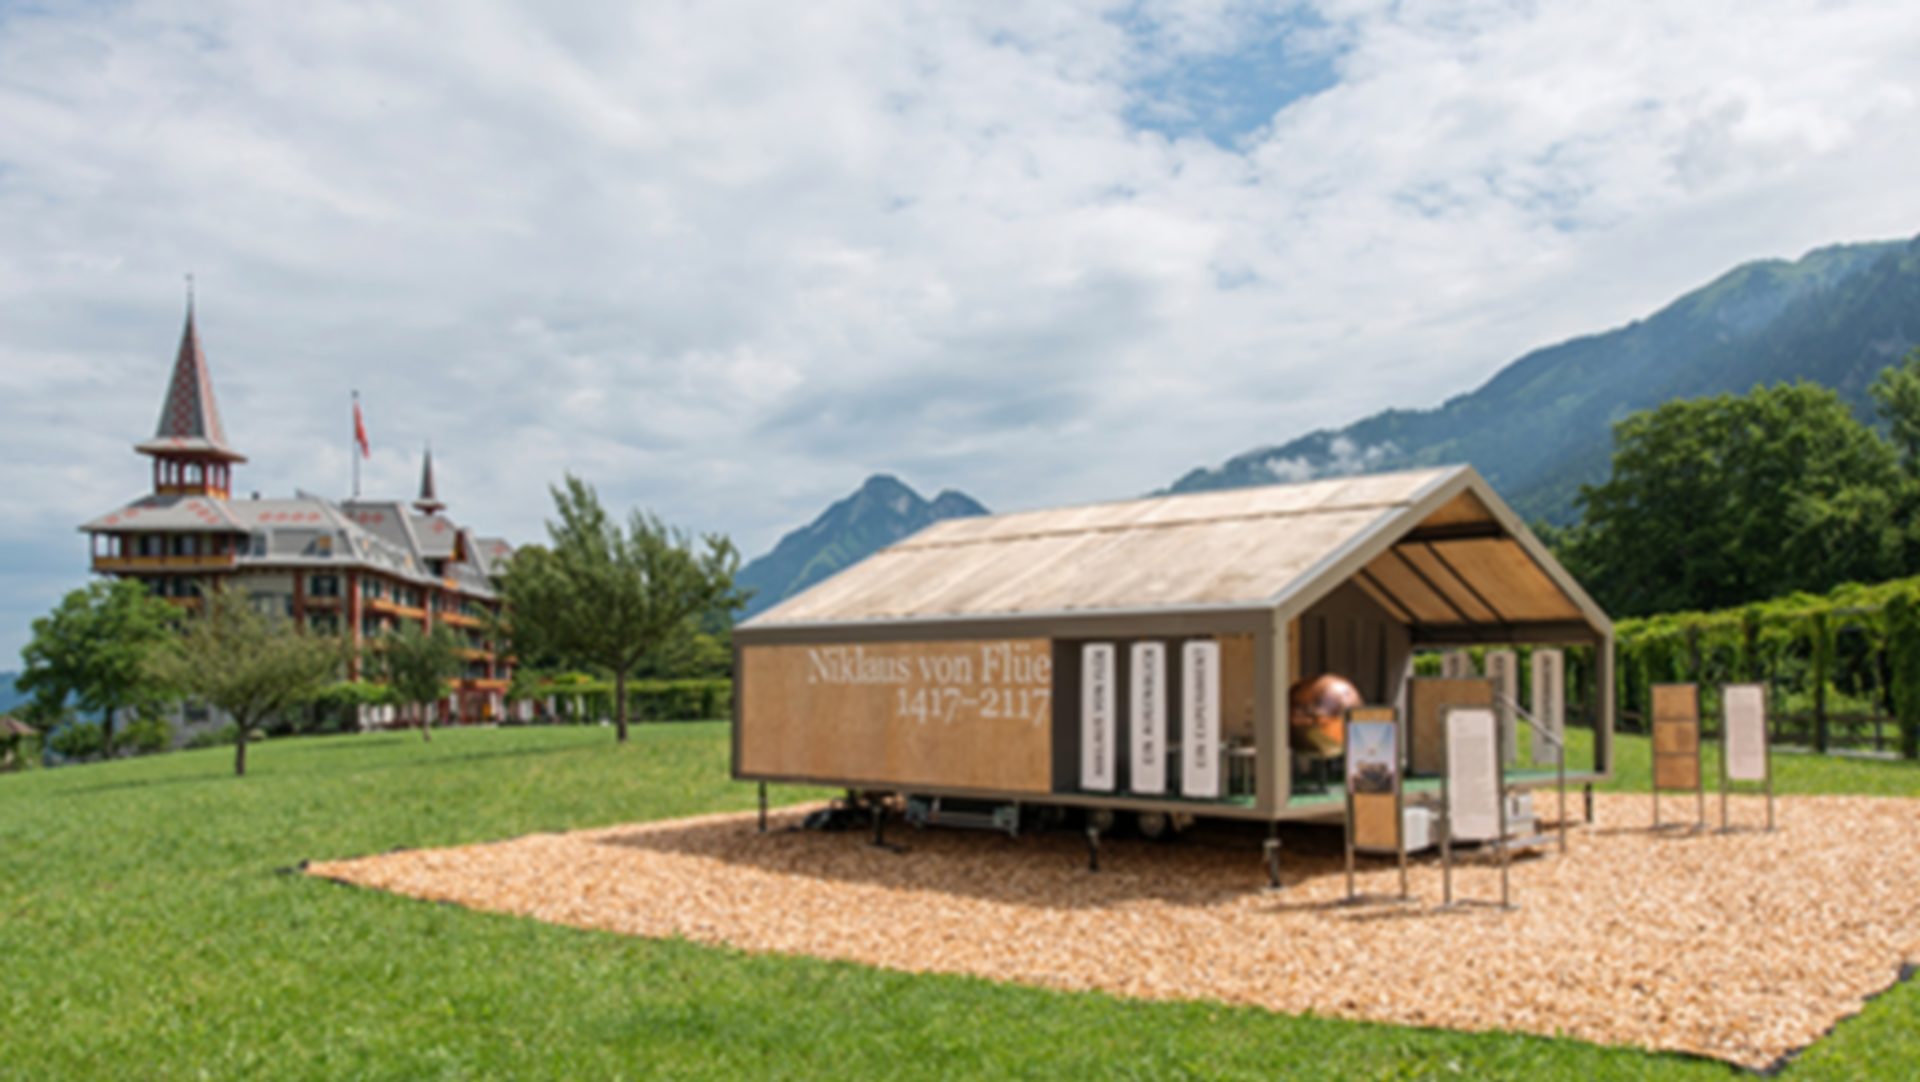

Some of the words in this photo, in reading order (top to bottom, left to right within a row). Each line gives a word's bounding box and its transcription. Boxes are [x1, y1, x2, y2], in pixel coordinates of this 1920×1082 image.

[807, 642, 911, 684] Niklaus
[917, 653, 973, 684] von
[981, 641, 1052, 684] Flüe
